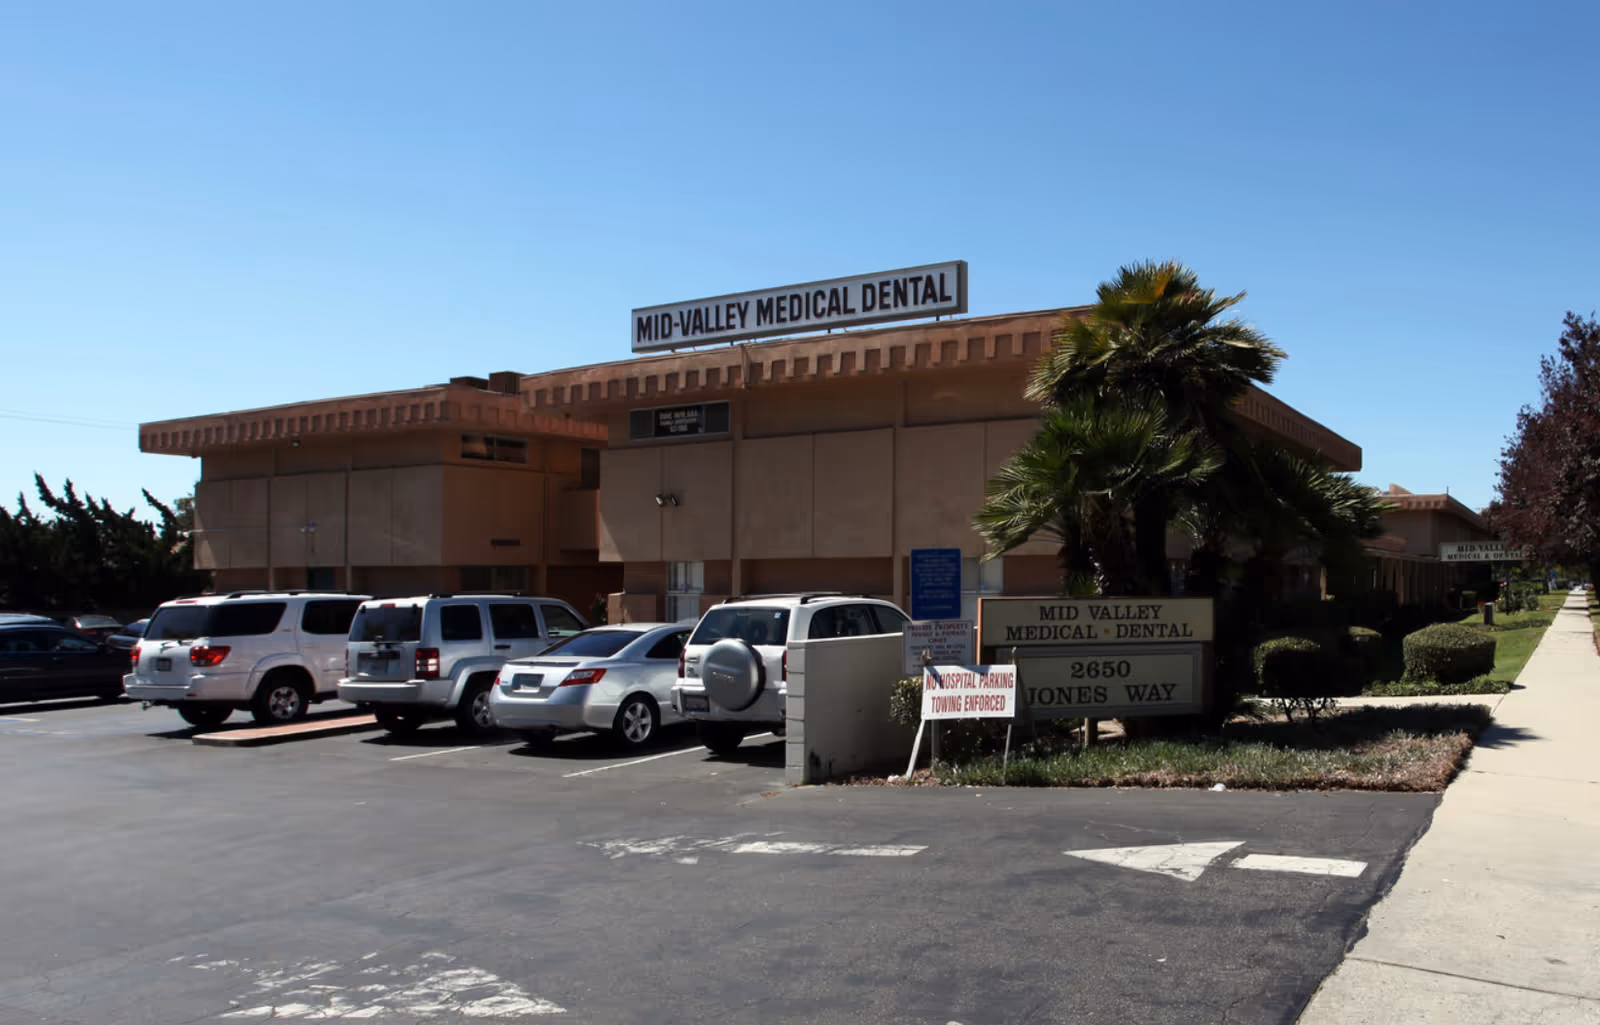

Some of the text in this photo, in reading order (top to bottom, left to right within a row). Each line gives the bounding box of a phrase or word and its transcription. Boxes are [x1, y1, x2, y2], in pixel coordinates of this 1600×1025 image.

[636, 273, 952, 343] MID-VALLEY MEDICAL DENTAL
[1039, 604, 1162, 621] MID VALLEY
[1006, 623, 1193, 641] MEDICAL DENTAL
[1070, 660, 1131, 680] 2650
[926, 672, 1014, 690] NO HOSPITAL PARKING
[931, 694, 1006, 713] TOWING ENFORCED
[1027, 683, 1179, 706] JONES WAY
